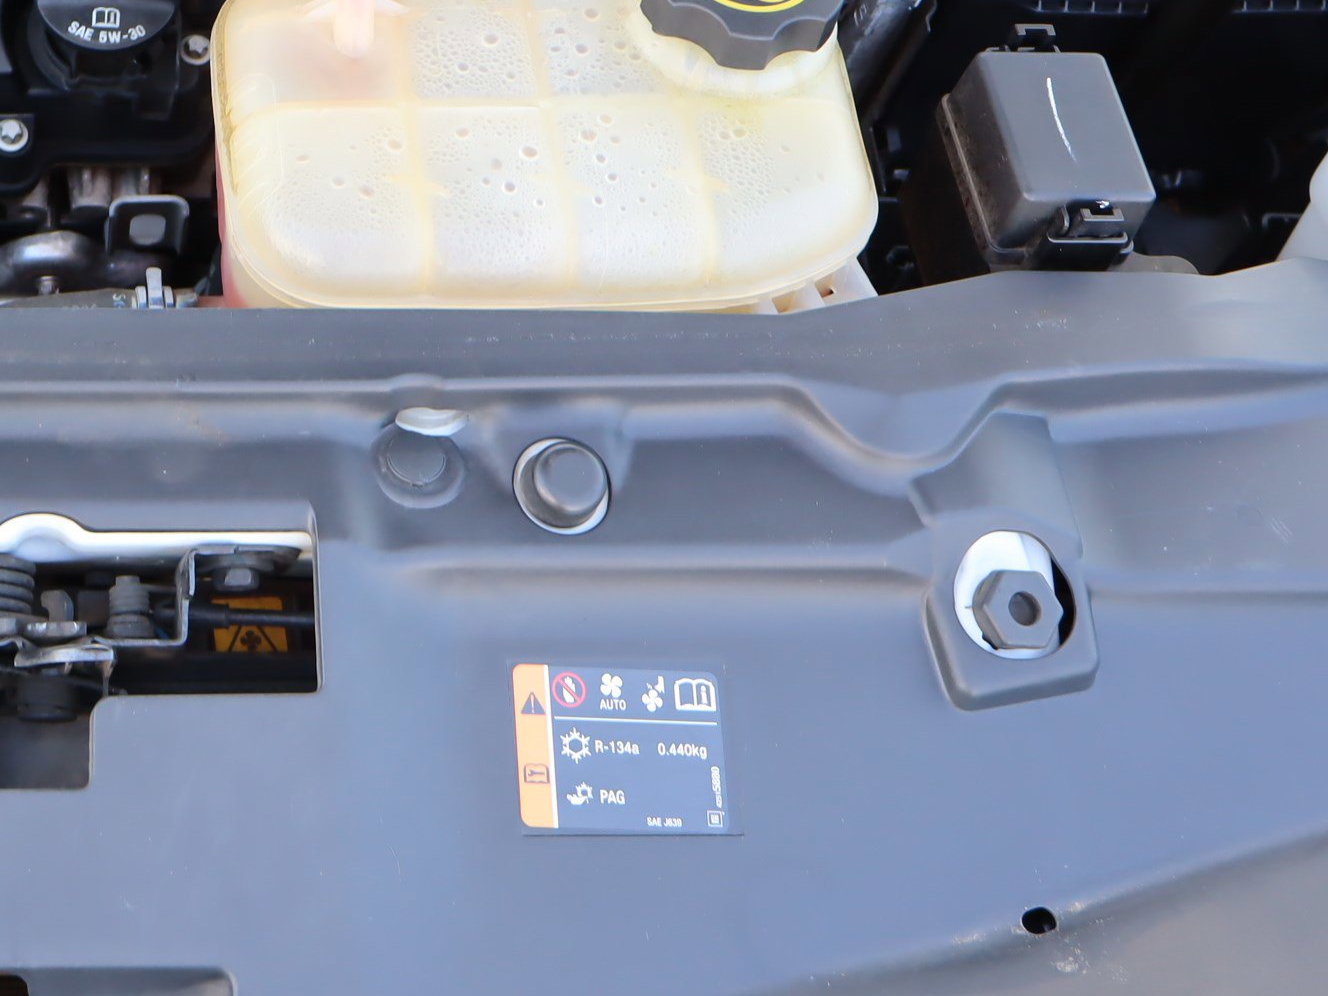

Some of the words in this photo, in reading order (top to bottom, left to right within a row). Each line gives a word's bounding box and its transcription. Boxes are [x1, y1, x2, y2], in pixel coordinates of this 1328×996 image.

[68, 21, 94, 41] SAE
[99, 24, 146, 44] 5W-30
[600, 699, 627, 711] AUTO
[595, 740, 640, 755] R-134a
[657, 742, 708, 760] 0.440kg
[600, 790, 626, 805] PAG
[647, 817, 662, 827] SAE
